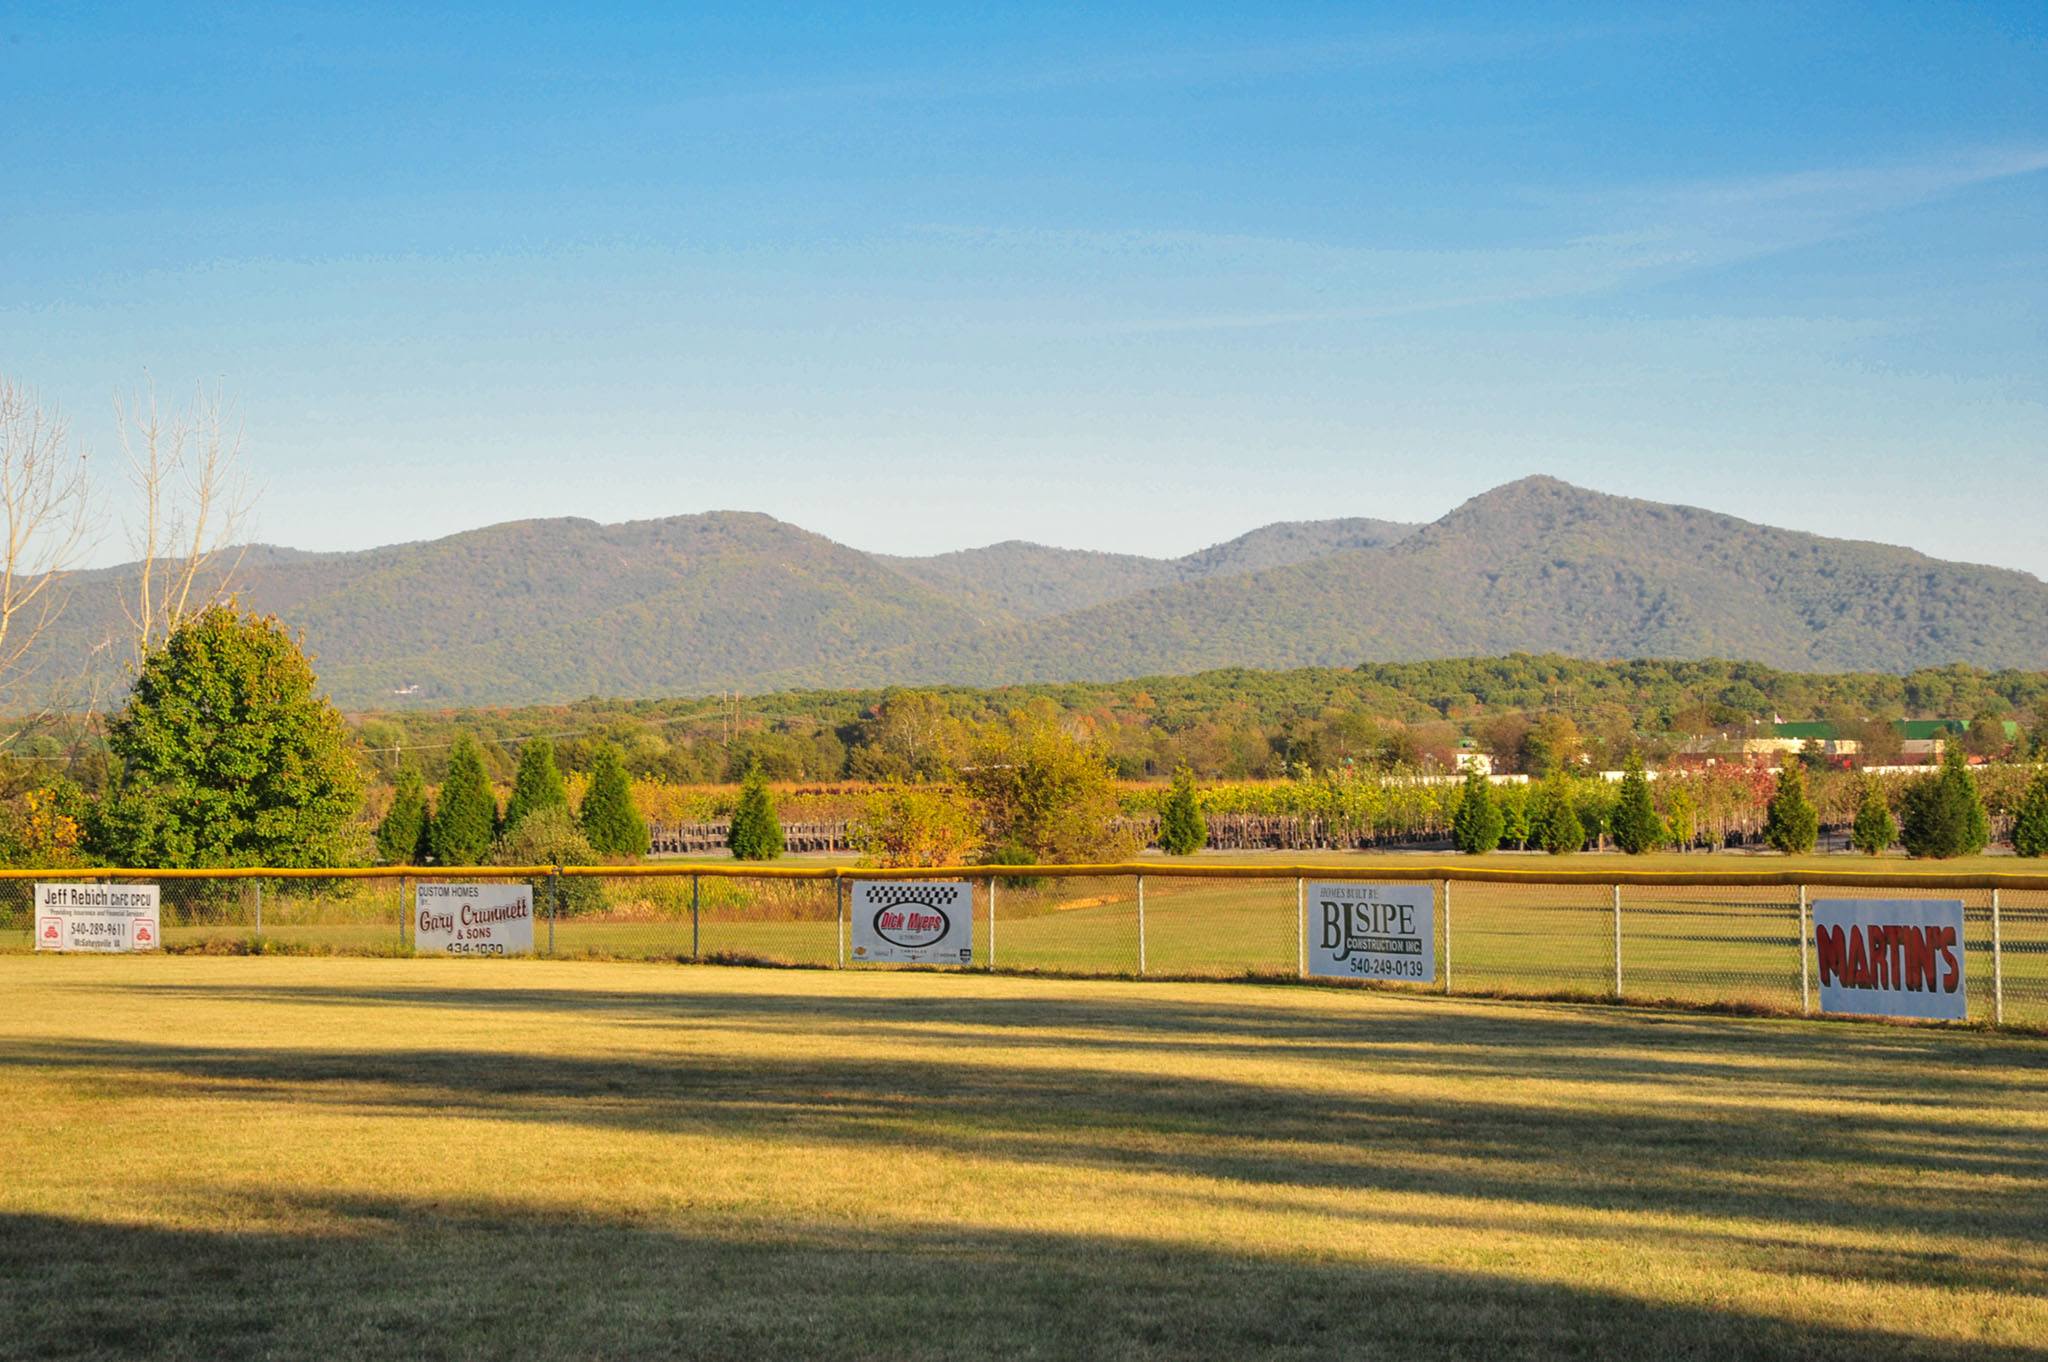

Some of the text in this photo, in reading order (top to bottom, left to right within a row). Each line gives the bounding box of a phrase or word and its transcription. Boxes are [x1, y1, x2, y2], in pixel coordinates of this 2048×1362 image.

[45, 889, 151, 906] Jeff Rebich ChFC CPCU
[418, 887, 478, 897] CUSTOM HOMES
[1320, 888, 1345, 897] HOMES
[1347, 889, 1368, 899] BUILT
[420, 898, 527, 934] Gary Crummett
[881, 912, 942, 933] Dick Myers
[71, 923, 125, 935] 540-289-9611
[457, 928, 491, 940] & SONS
[1320, 901, 1416, 961] BJ SIPE
[447, 943, 503, 954] 434-1030
[1347, 938, 1422, 952] CONSTRUCTION INC.
[1816, 924, 1959, 993] MARTIN'S
[1351, 958, 1423, 976] 540-249-0139
